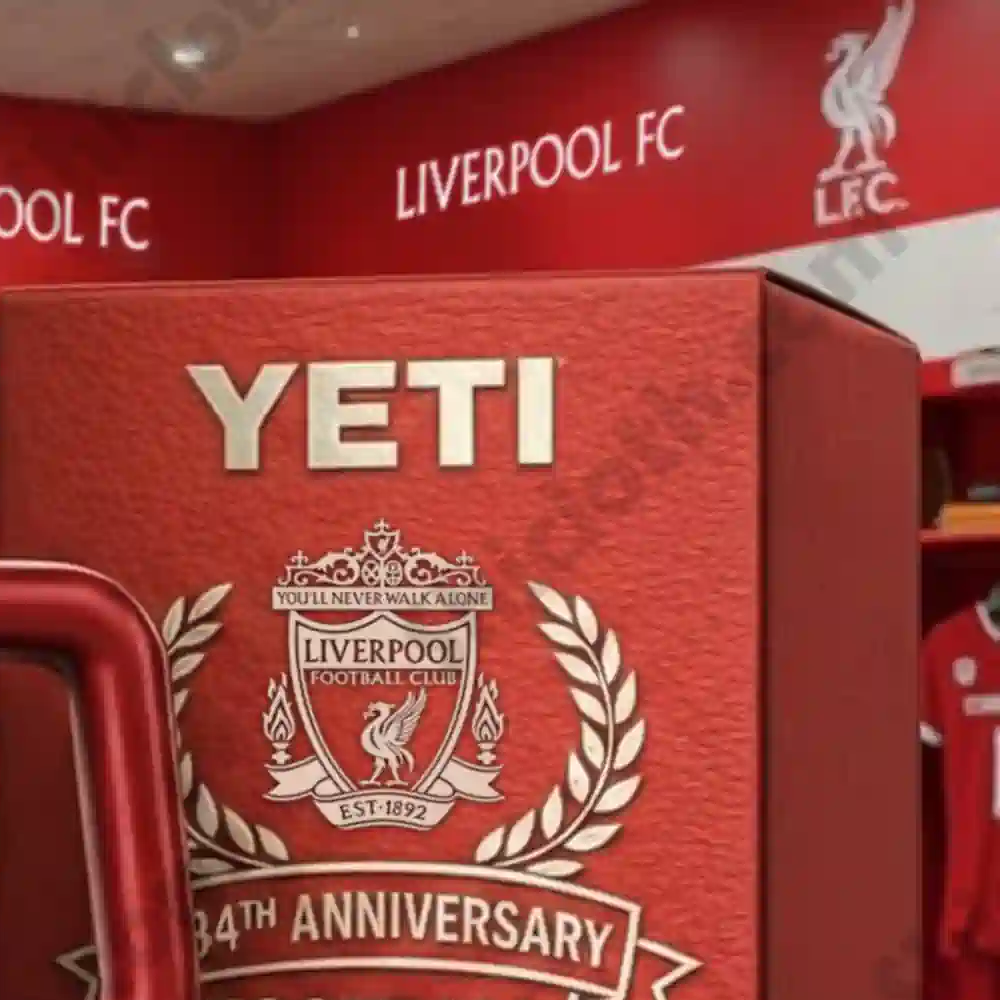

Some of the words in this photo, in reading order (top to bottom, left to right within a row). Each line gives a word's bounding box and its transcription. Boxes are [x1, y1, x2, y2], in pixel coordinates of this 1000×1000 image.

[396, 121, 621, 221] LIVERPOOL
[636, 105, 686, 166] FC
[99, 196, 150, 250] FC
[186, 356, 555, 471] YETI
[277, 591, 329, 606] YOU'LL
[331, 591, 385, 606] NEVER
[387, 591, 434, 606] WALK
[436, 591, 489, 606] ALONE
[304, 638, 464, 665] LIVERPOOL
[310, 671, 406, 686] FOOTBALL
[408, 671, 457, 686] CLUB
[192, 896, 277, 959] 34TH
[290, 890, 614, 967] ANNIVERSARY
